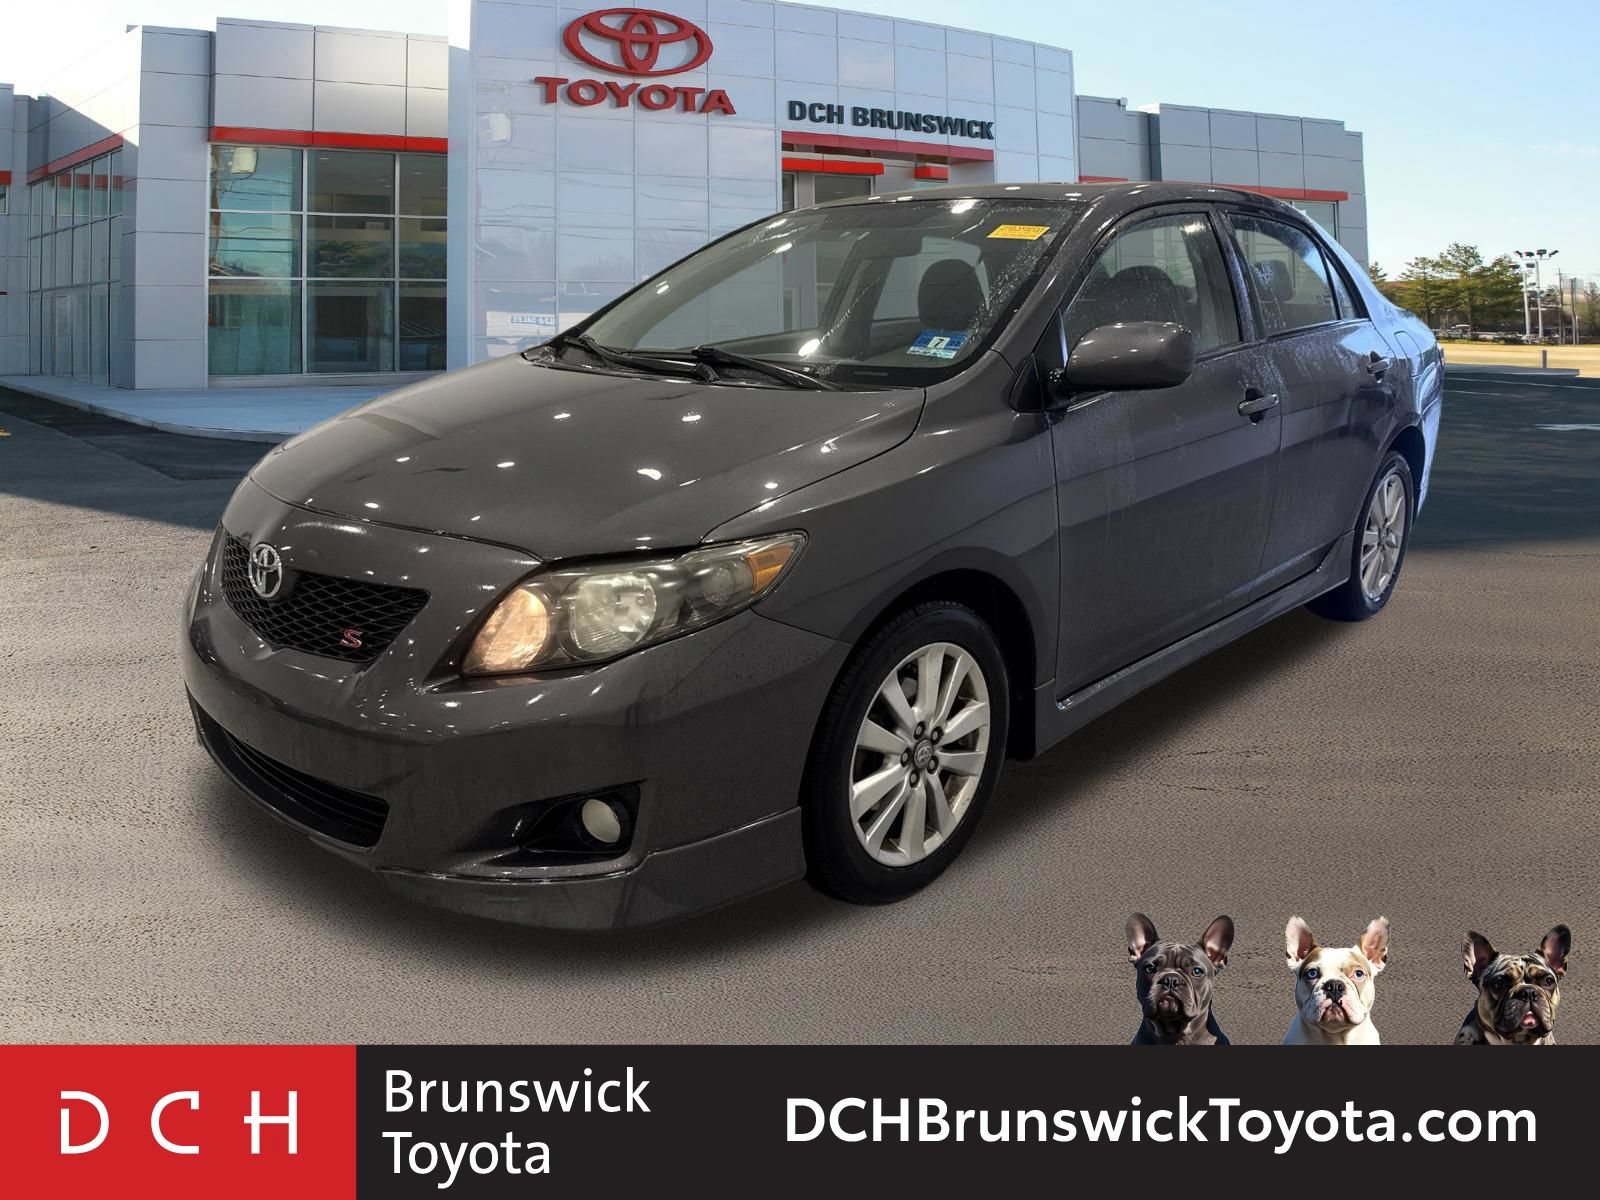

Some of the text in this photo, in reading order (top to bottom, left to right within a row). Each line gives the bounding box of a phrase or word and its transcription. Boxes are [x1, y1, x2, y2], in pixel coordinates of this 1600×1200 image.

[534, 76, 737, 115] TOYOTA
[788, 100, 995, 140] DCH BRUNSWICK
[340, 629, 363, 648] S
